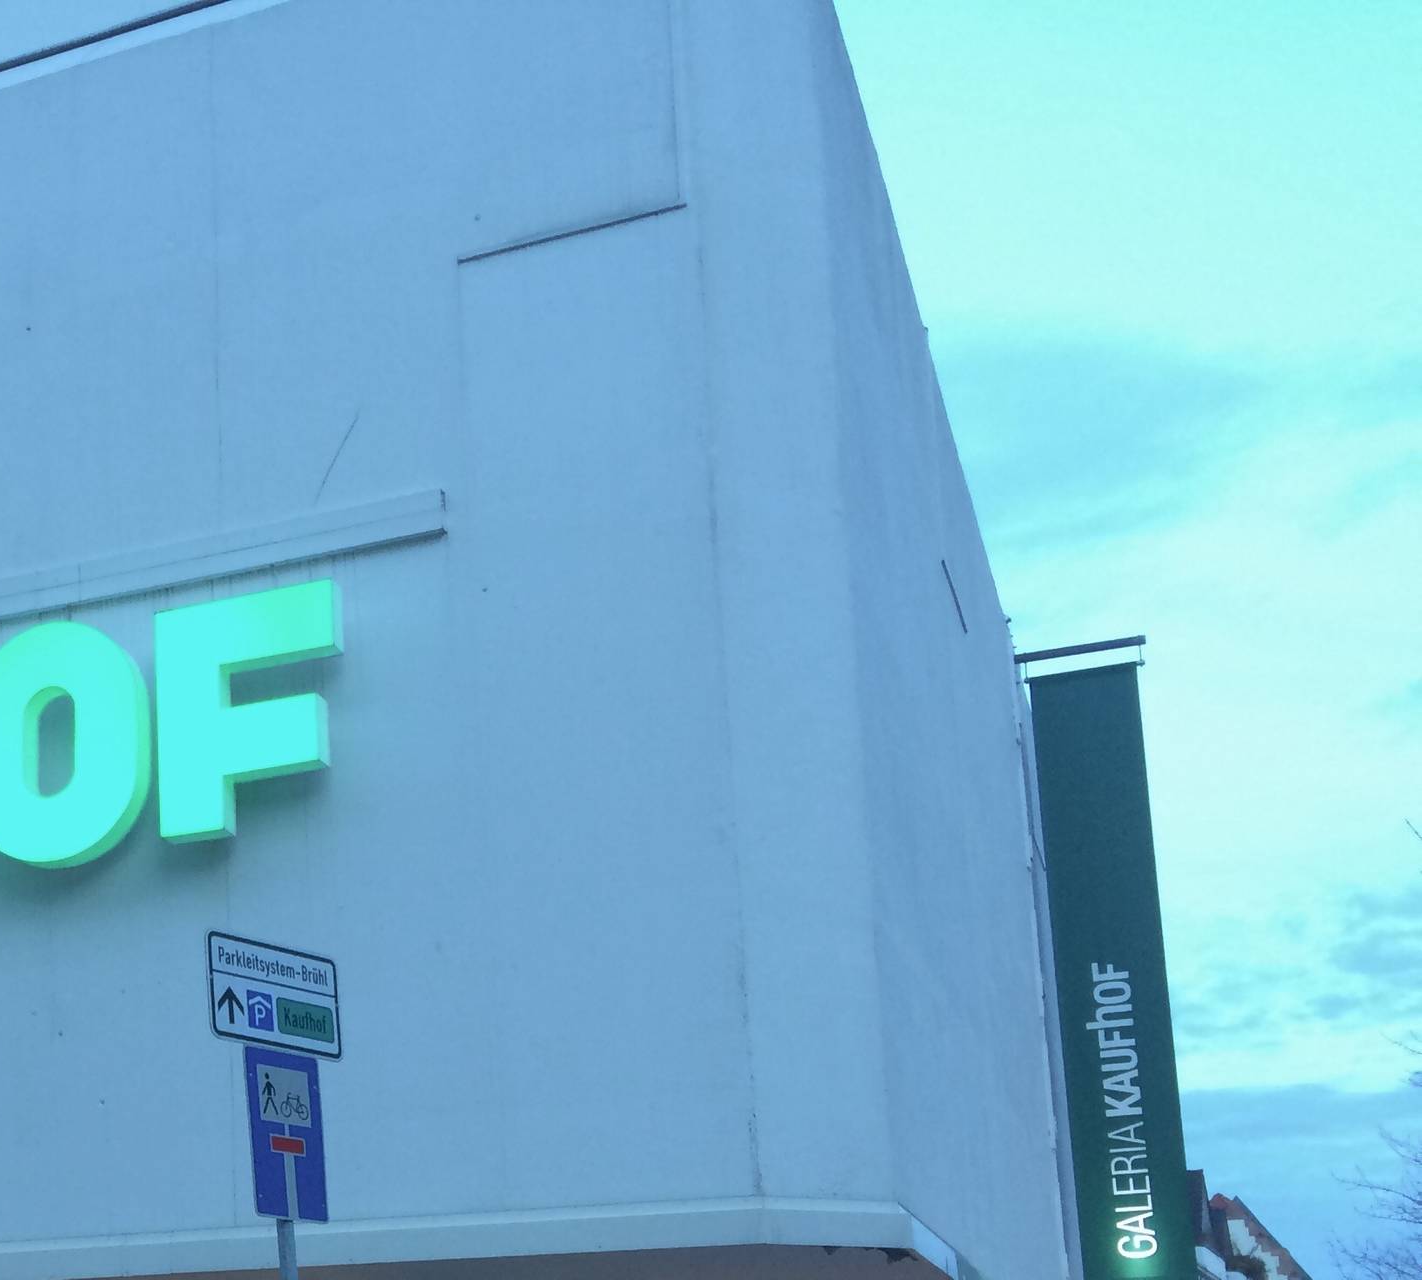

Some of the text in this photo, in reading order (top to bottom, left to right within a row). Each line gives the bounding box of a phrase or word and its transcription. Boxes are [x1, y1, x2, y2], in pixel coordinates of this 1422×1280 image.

[218, 946, 328, 986] Parkleitsystem-Brühl
[254, 1004, 266, 1026] P
[283, 1007, 327, 1034] Kaufhof
[1107, 1121, 1158, 1260] GALERIA
